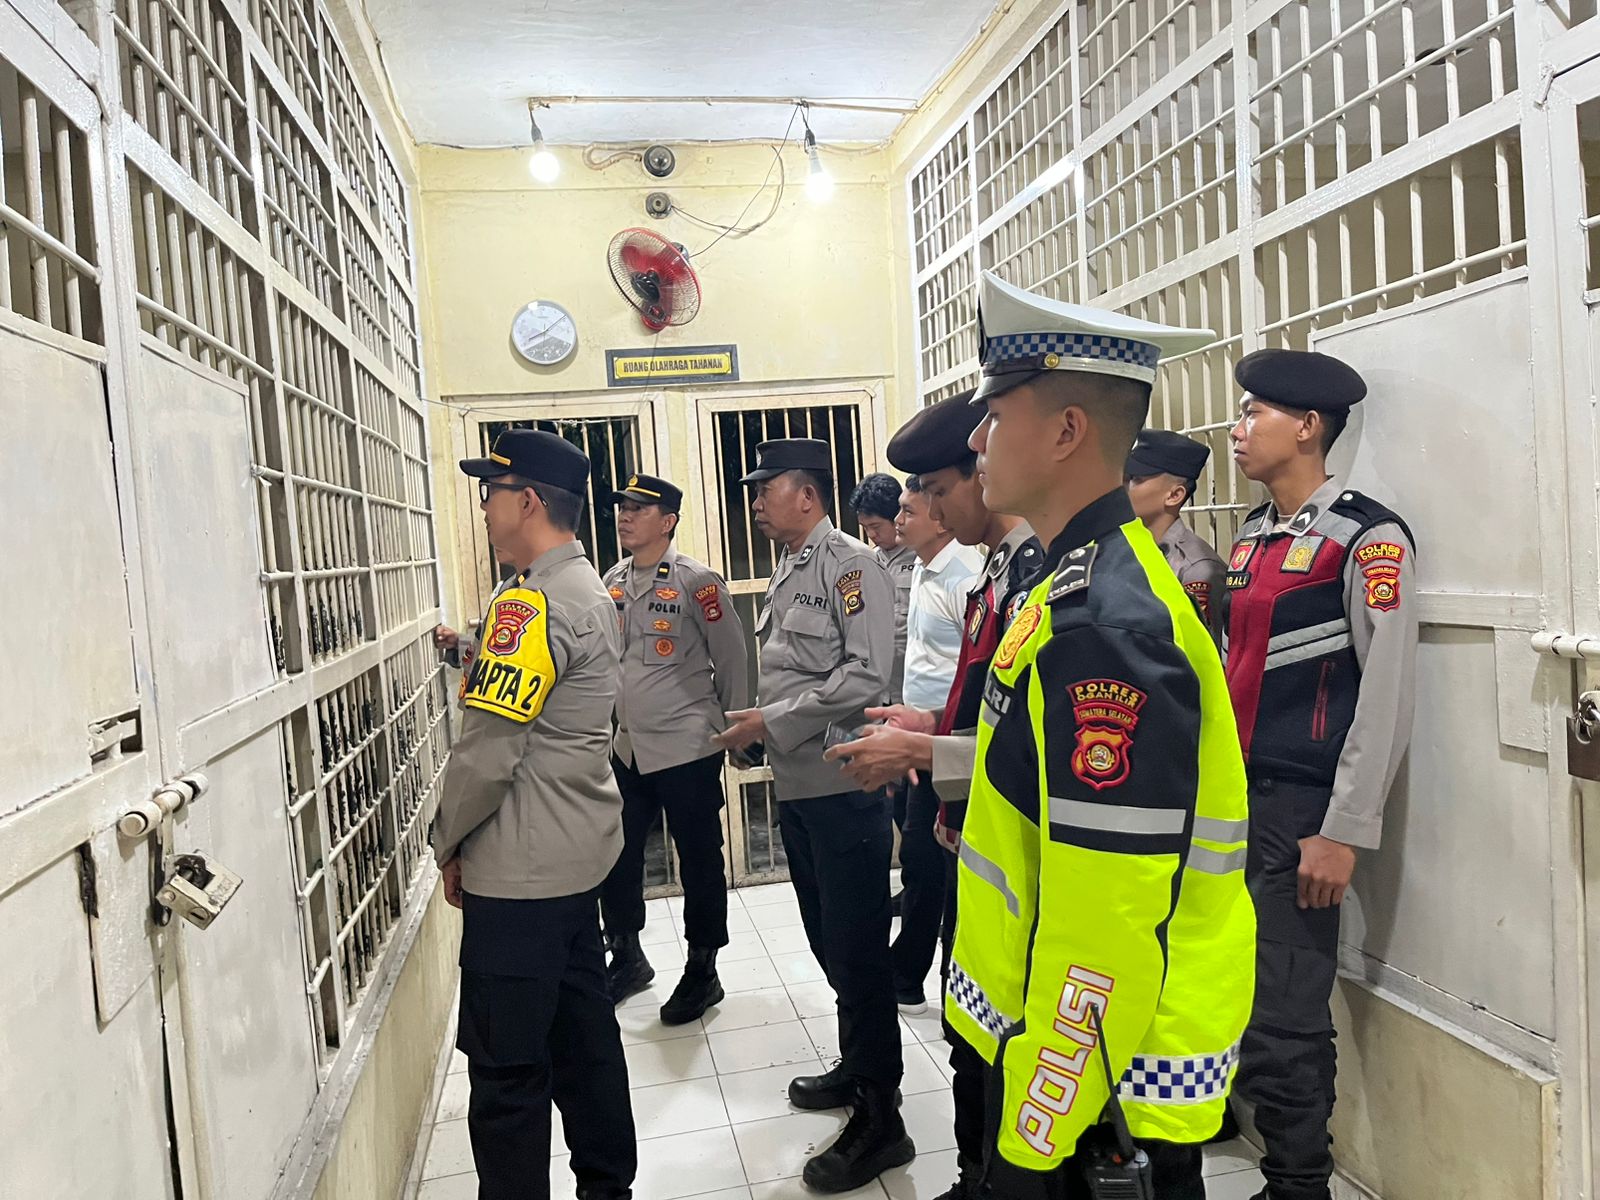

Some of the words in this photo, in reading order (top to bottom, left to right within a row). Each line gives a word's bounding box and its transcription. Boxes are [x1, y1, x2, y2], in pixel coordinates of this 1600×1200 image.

[623, 361, 649, 373] RUANG
[649, 359, 689, 372] OLAHRAGA
[689, 358, 723, 370] TAHANAN
[1359, 544, 1401, 557] POLRES
[648, 602, 681, 615] POLRI
[793, 592, 828, 609] POLRI
[521, 675, 542, 710] 2
[1075, 682, 1139, 703] POLRES
[1077, 691, 1113, 701] OGAN
[1115, 694, 1136, 709] ILIR
[1016, 965, 1115, 1158] POLISI
